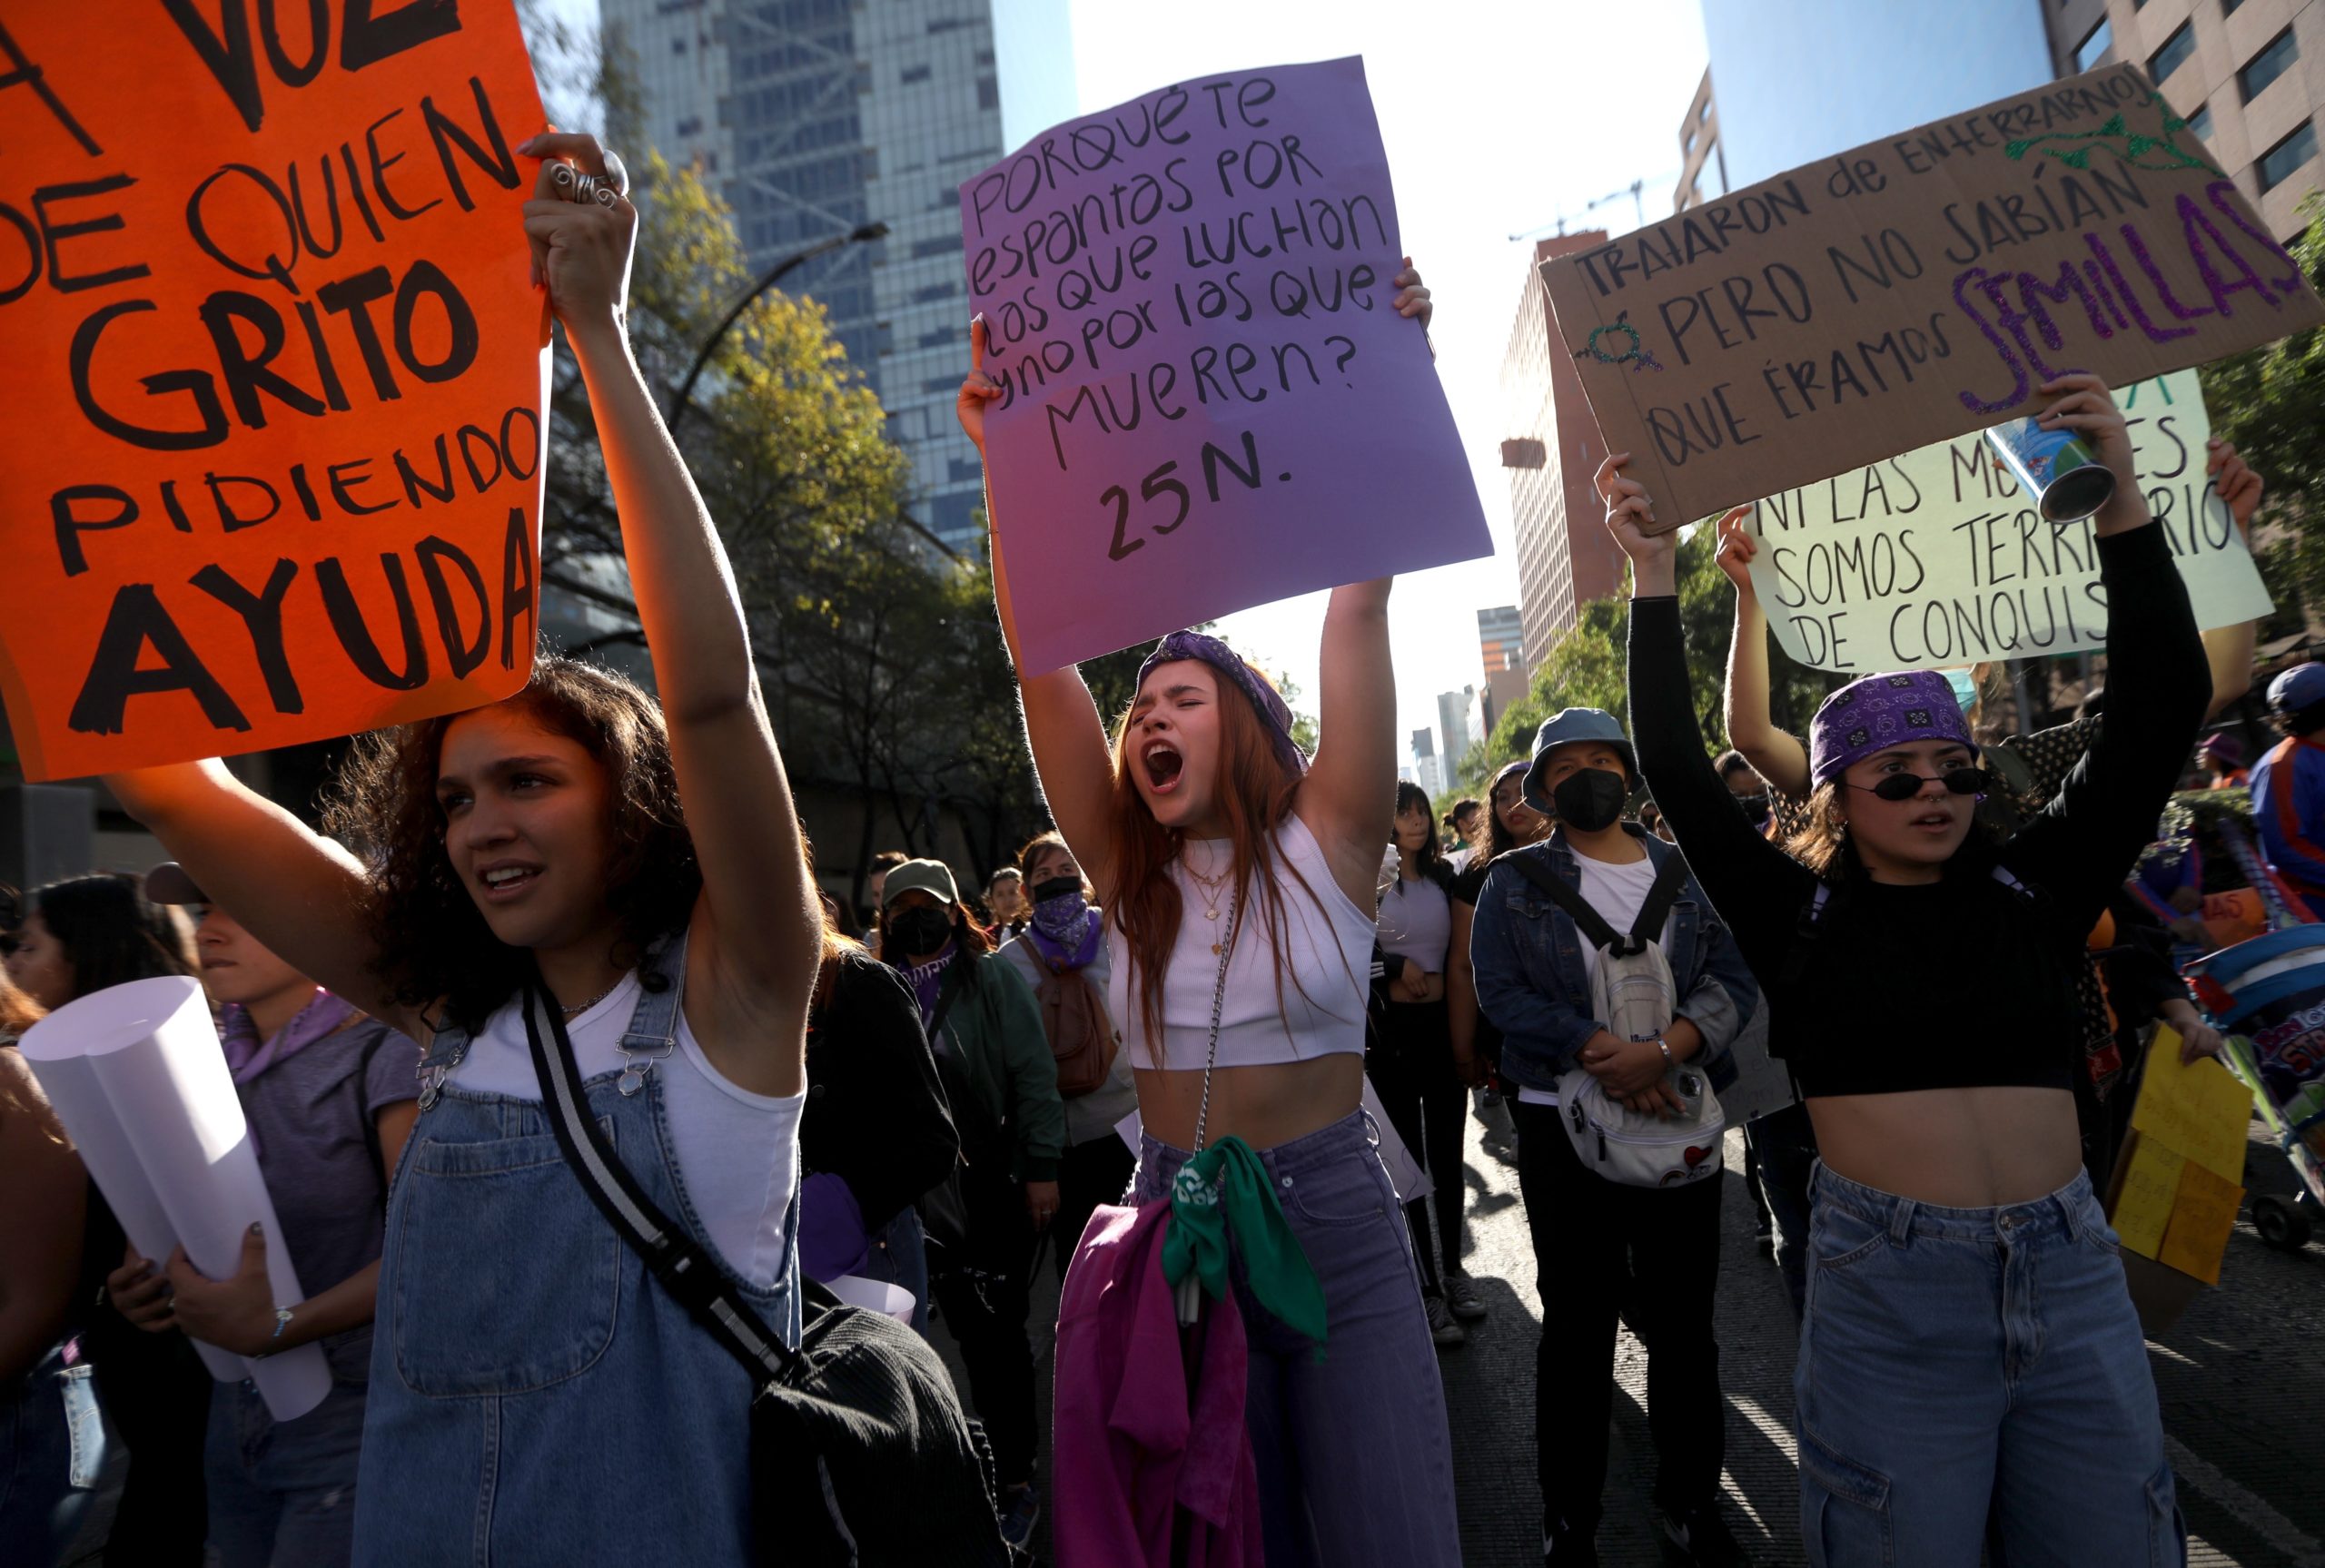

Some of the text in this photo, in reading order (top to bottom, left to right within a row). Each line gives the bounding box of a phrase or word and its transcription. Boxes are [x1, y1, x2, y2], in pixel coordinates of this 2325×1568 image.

[186, 76, 522, 294] QUIEN
[1217, 134, 1323, 197] POR
[1827, 157, 1887, 199] de
[1645, 182, 2301, 467] QUE ÉRAMOS SEMILLAS
[1658, 161, 2150, 365] PERO NO SABÍAN
[69, 259, 479, 451] GRITO
[50, 407, 541, 577] PIDIENDO
[1755, 488, 1806, 536] NI
[1829, 454, 1922, 525] LAS
[1772, 481, 2231, 609] SOMOS TERRIRIO
[68, 507, 534, 735] AYUDA
[1789, 581, 2107, 667] DE CONQUIS
